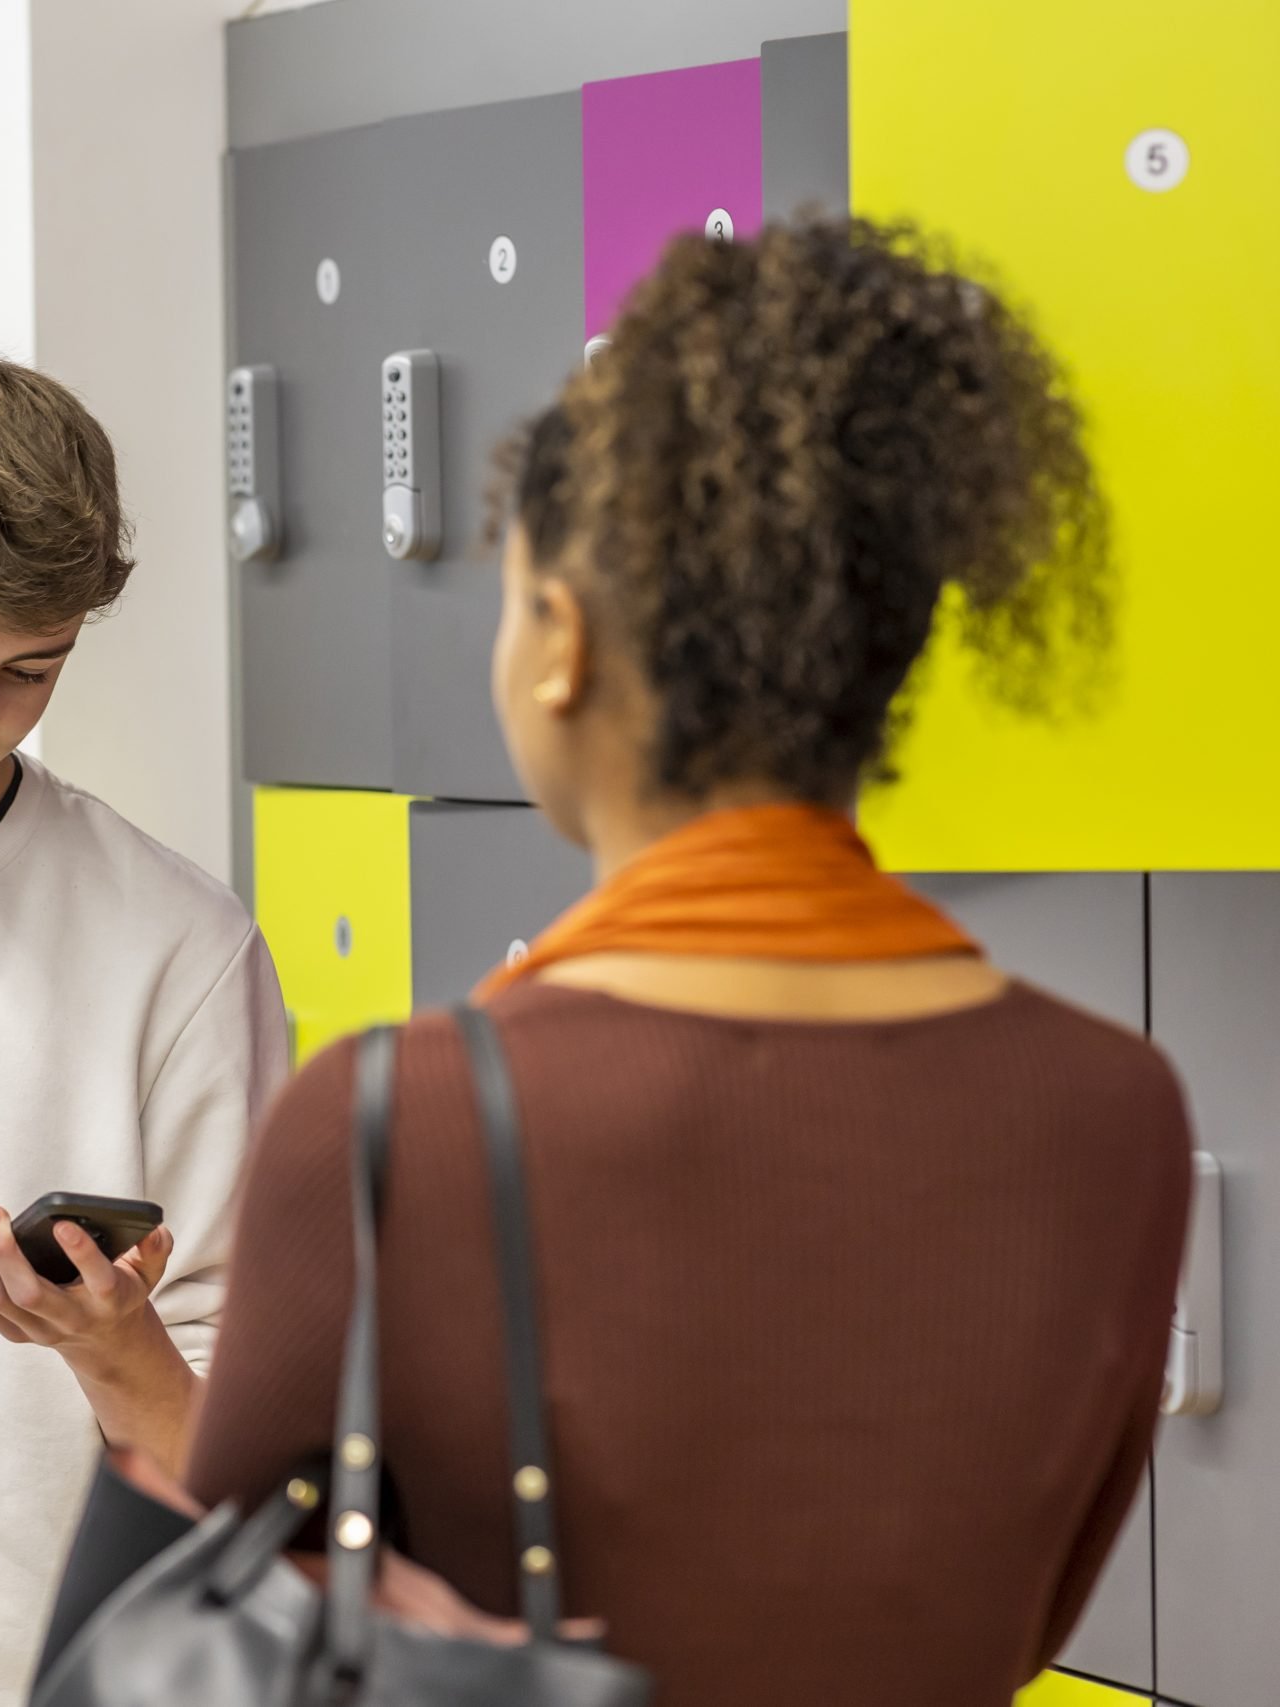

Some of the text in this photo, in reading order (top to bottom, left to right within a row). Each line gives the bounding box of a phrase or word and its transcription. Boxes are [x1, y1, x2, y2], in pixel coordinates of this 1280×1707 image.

[1146, 143, 1168, 177] 5
[714, 220, 724, 241] 3
[498, 248, 508, 271] 2
